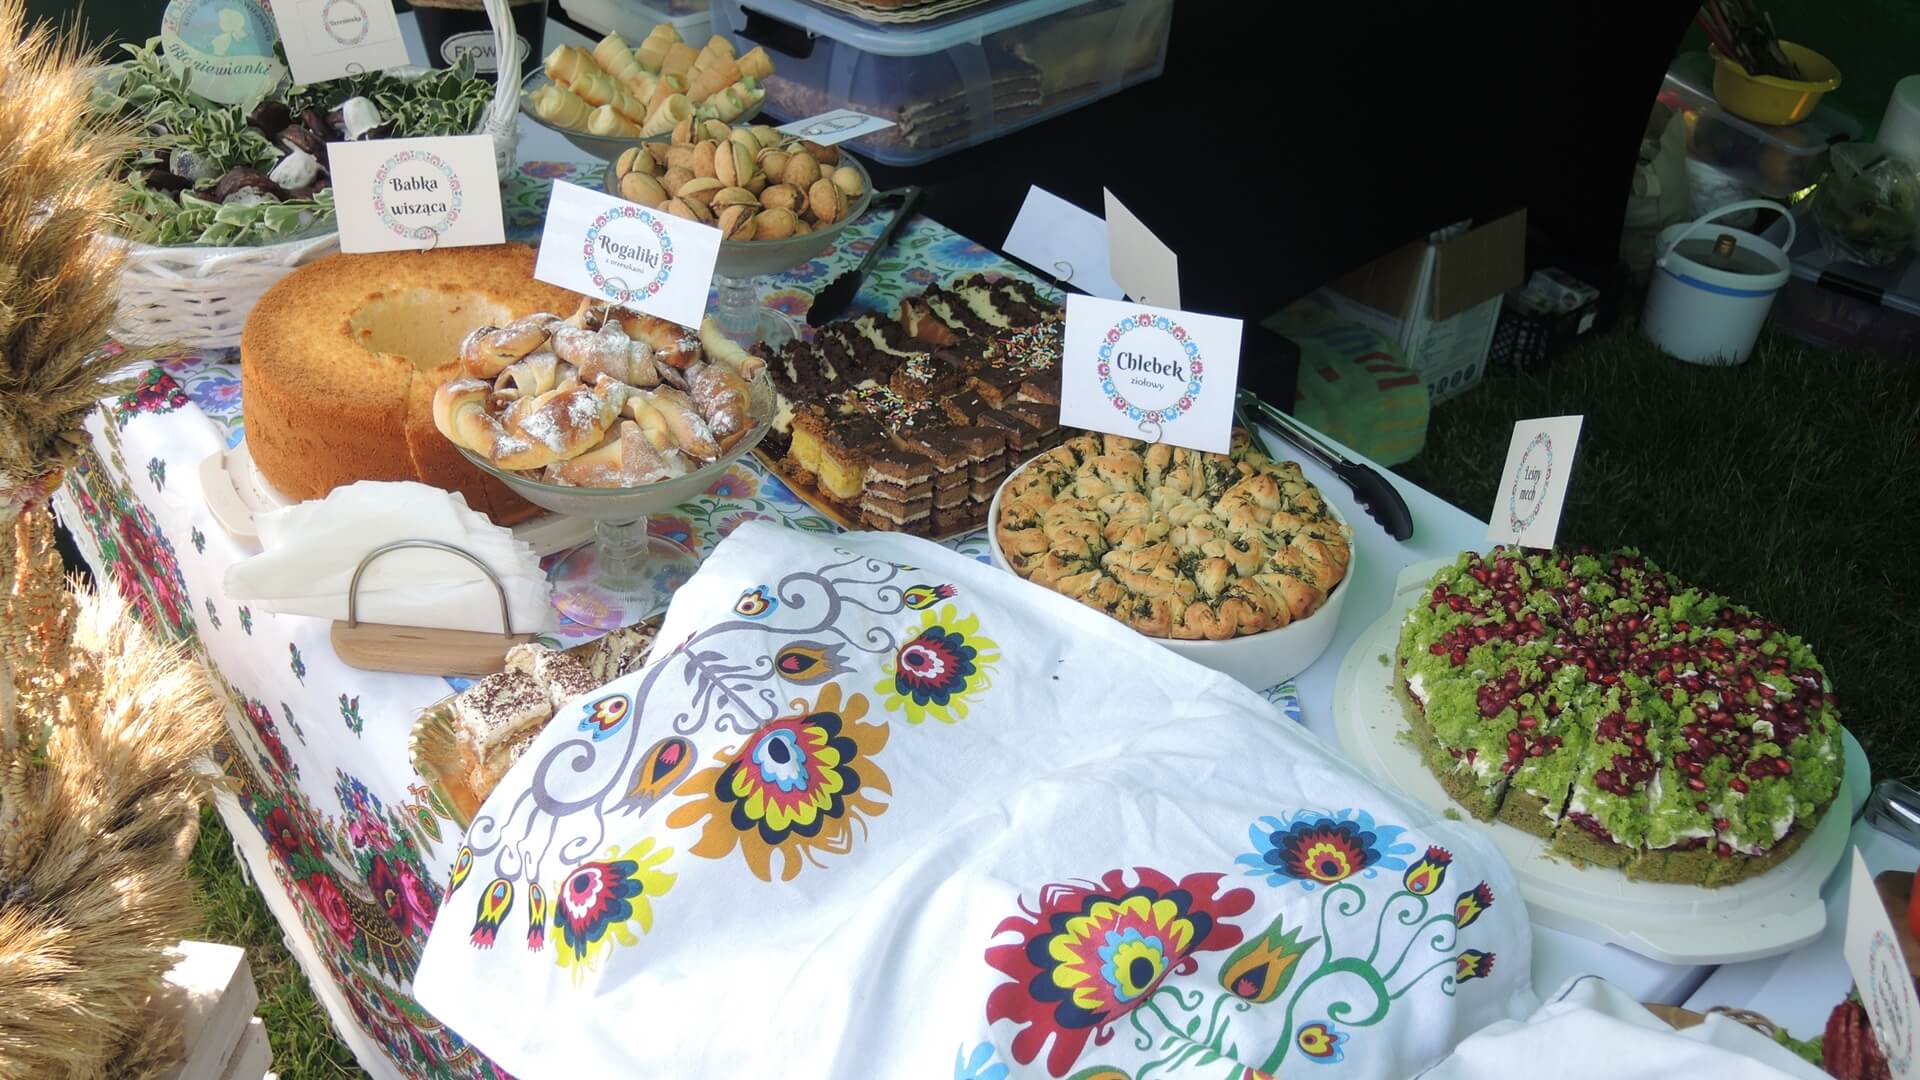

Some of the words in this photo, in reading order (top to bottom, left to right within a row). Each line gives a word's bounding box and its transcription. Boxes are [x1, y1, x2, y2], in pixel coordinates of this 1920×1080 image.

[389, 175, 438, 192] Babka
[391, 202, 446, 216] wisząca
[598, 234, 659, 269] Rogaliki
[1116, 351, 1186, 382] Chlebek
[1130, 376, 1165, 391] ziołowy
[1519, 486, 1536, 501] mech
